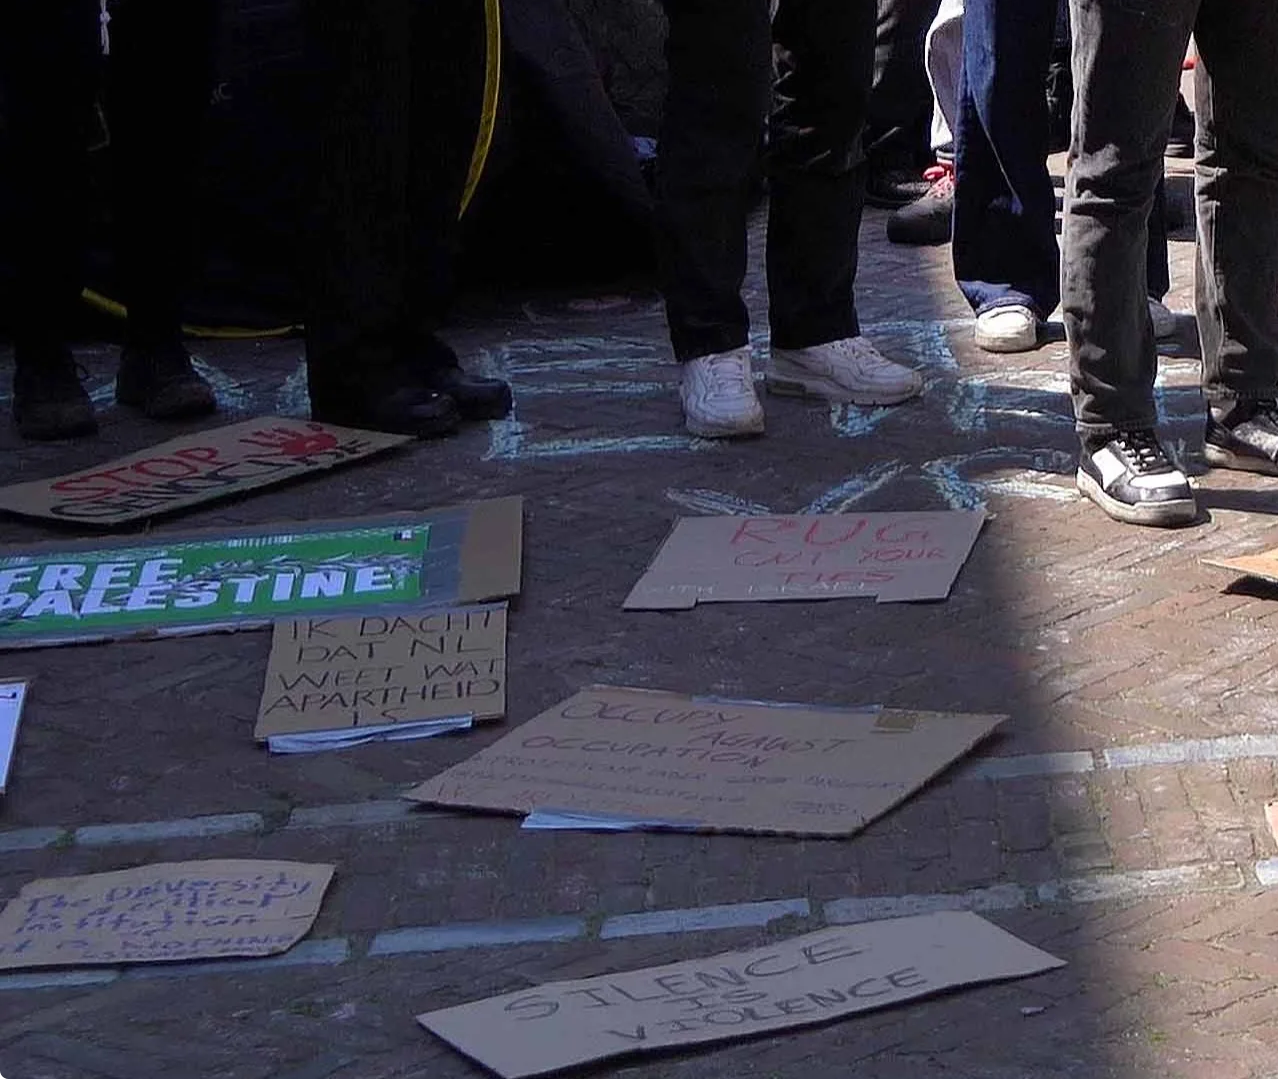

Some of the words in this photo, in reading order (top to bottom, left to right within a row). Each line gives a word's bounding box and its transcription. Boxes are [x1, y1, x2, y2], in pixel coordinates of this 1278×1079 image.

[48, 446, 222, 503] STOP
[729, 518, 932, 546] RUG
[0, 558, 183, 594] FREE
[290, 616, 338, 639] IK
[360, 608, 493, 638] DACHT
[295, 639, 376, 664] DAT
[410, 635, 493, 660] NL
[278, 666, 394, 690] WEET
[423, 657, 503, 680] WAT
[265, 679, 501, 715] APARTHEID
[353, 708, 400, 727] IS
[503, 935, 870, 1021] SILENCE
[607, 966, 929, 1042] VIOLENCE
